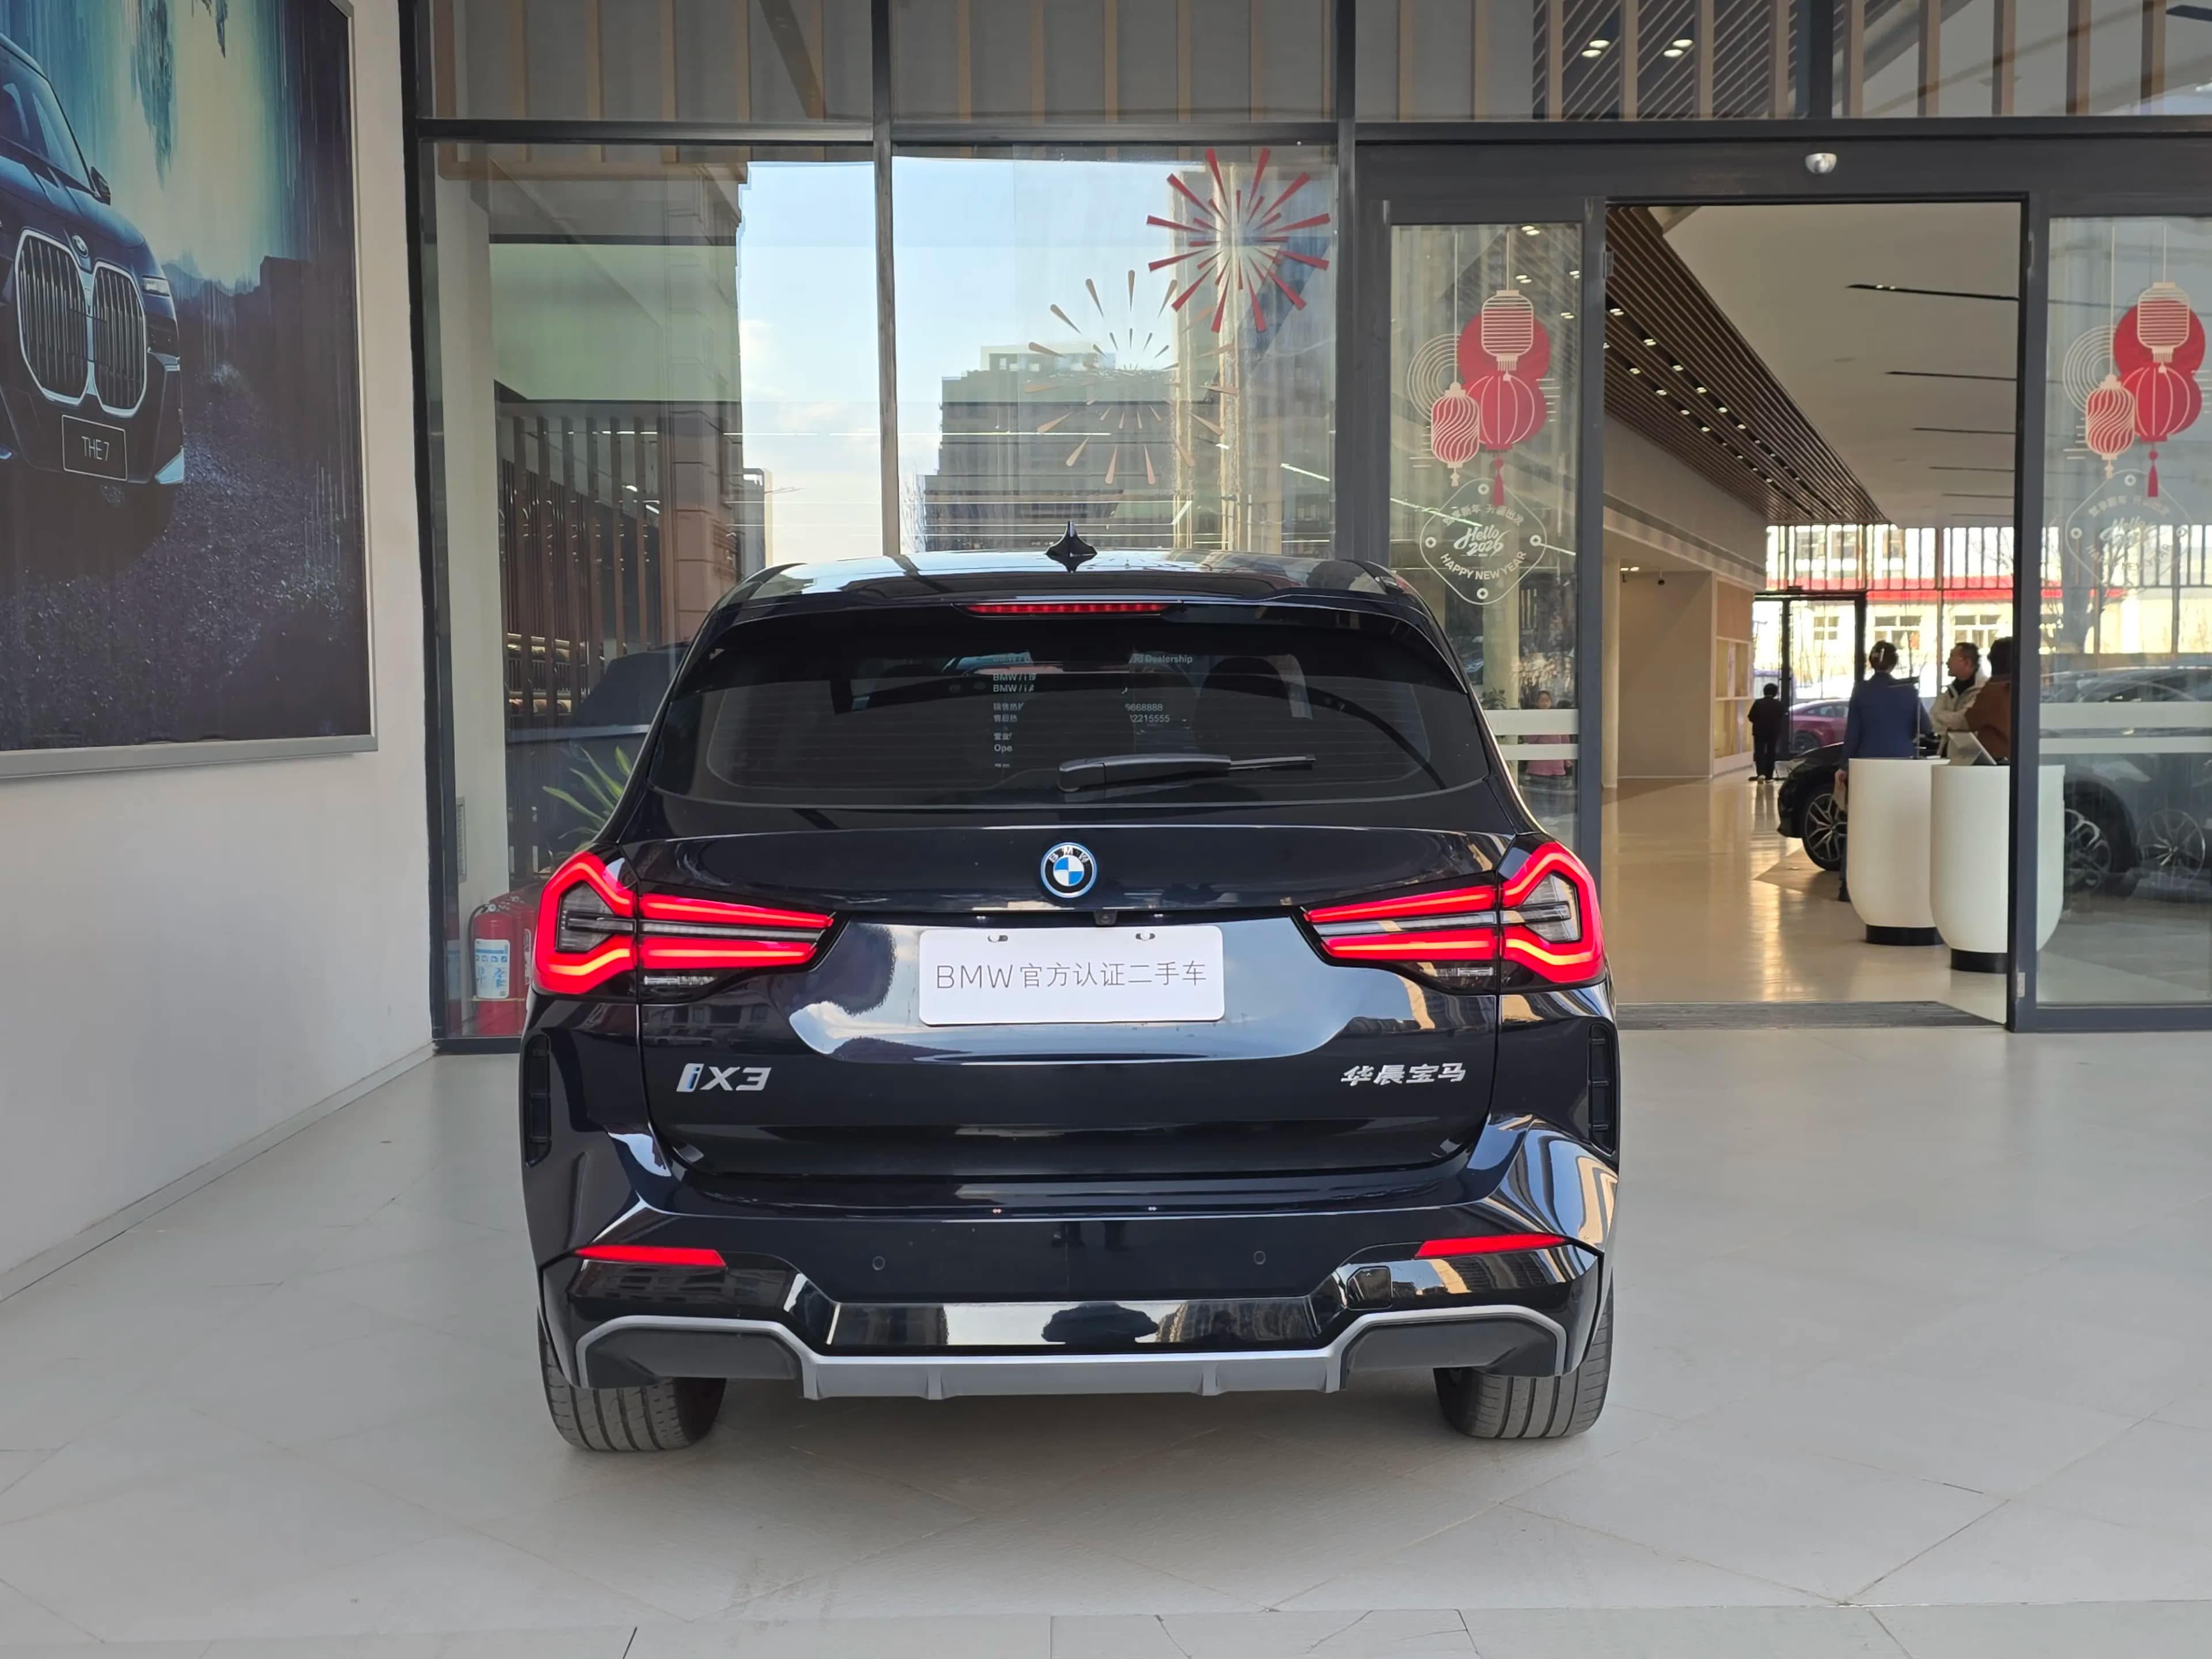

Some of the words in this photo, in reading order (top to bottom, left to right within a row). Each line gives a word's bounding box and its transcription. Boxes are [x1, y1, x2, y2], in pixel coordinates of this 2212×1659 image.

[1453, 524, 1500, 550] Hello
[1466, 529, 1512, 562] 2026
[1440, 552, 1474, 579] HAPPY
[1475, 570, 1500, 580] NEW
[1501, 551, 1527, 575] YEAR
[1145, 654, 1193, 664] Dealership
[993, 673, 1017, 681] BMW
[993, 684, 1017, 692] BMW
[1130, 714, 1171, 723] 2215555
[994, 744, 1014, 754] Ope
[1340, 1062, 1467, 1087] 华晨宝马
